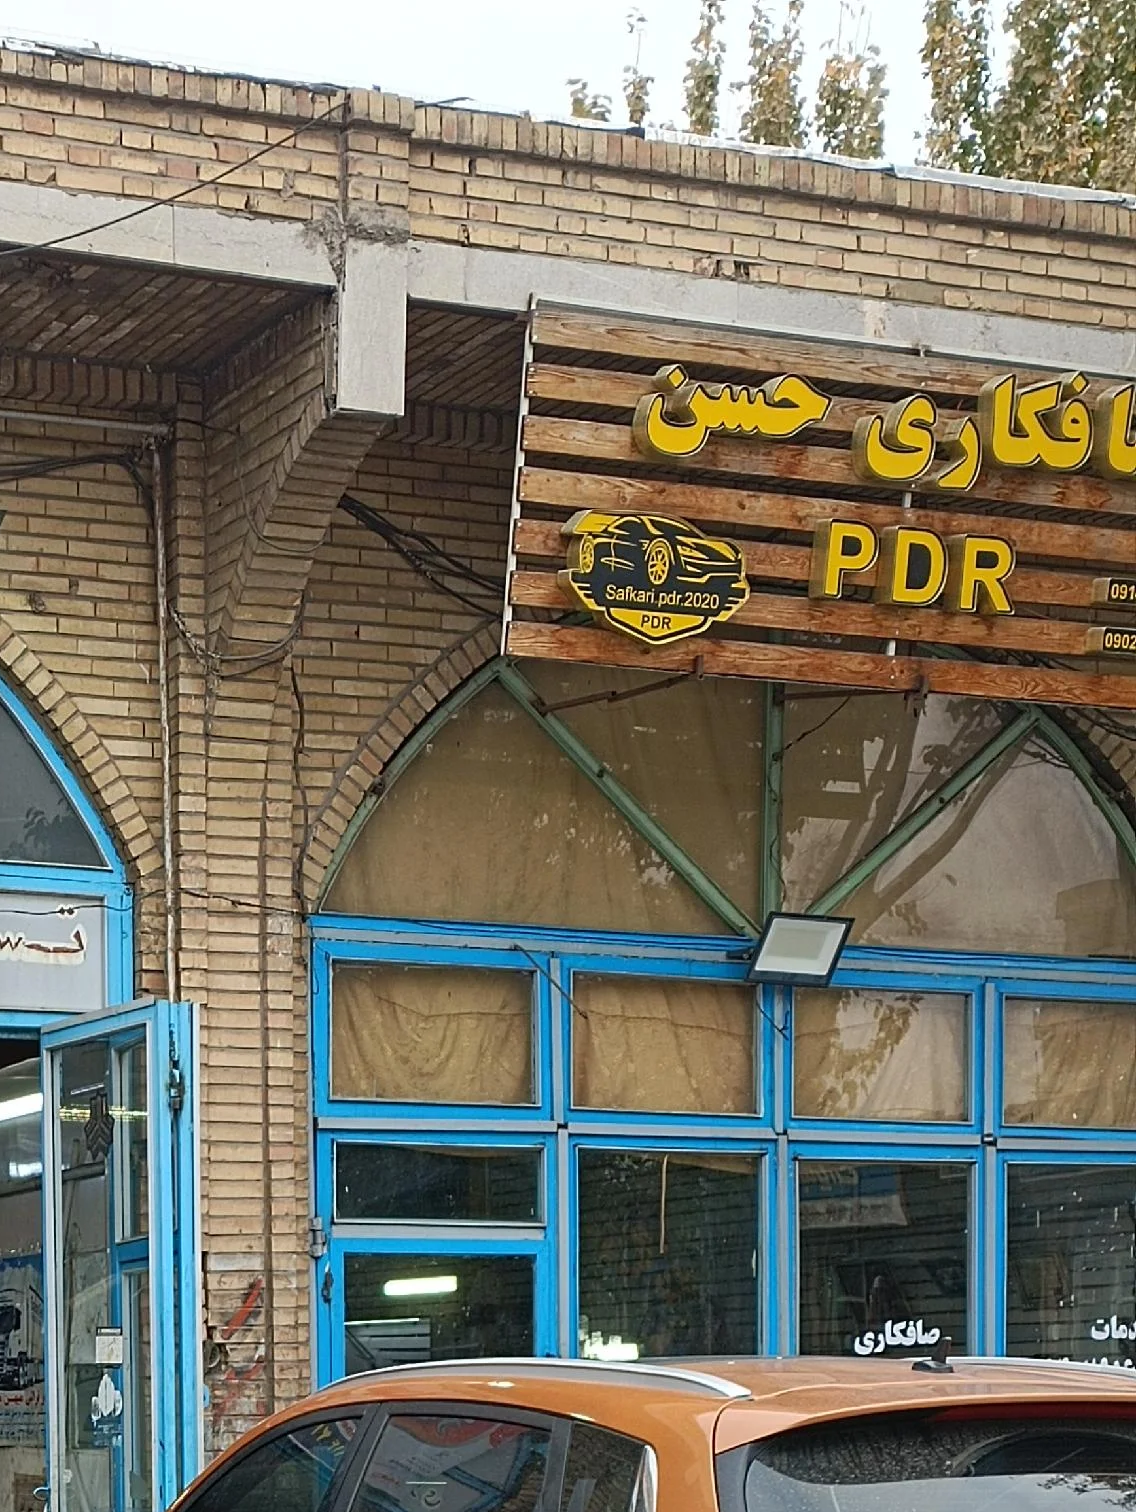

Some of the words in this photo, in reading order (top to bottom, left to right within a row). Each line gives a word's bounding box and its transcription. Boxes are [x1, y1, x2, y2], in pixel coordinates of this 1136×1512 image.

[638, 364, 833, 457] حسن
[818, 518, 1016, 616] PDR
[1111, 584, 1136, 600] 091
[641, 615, 671, 629] PDR
[854, 1318, 940, 1355] صافکاری
